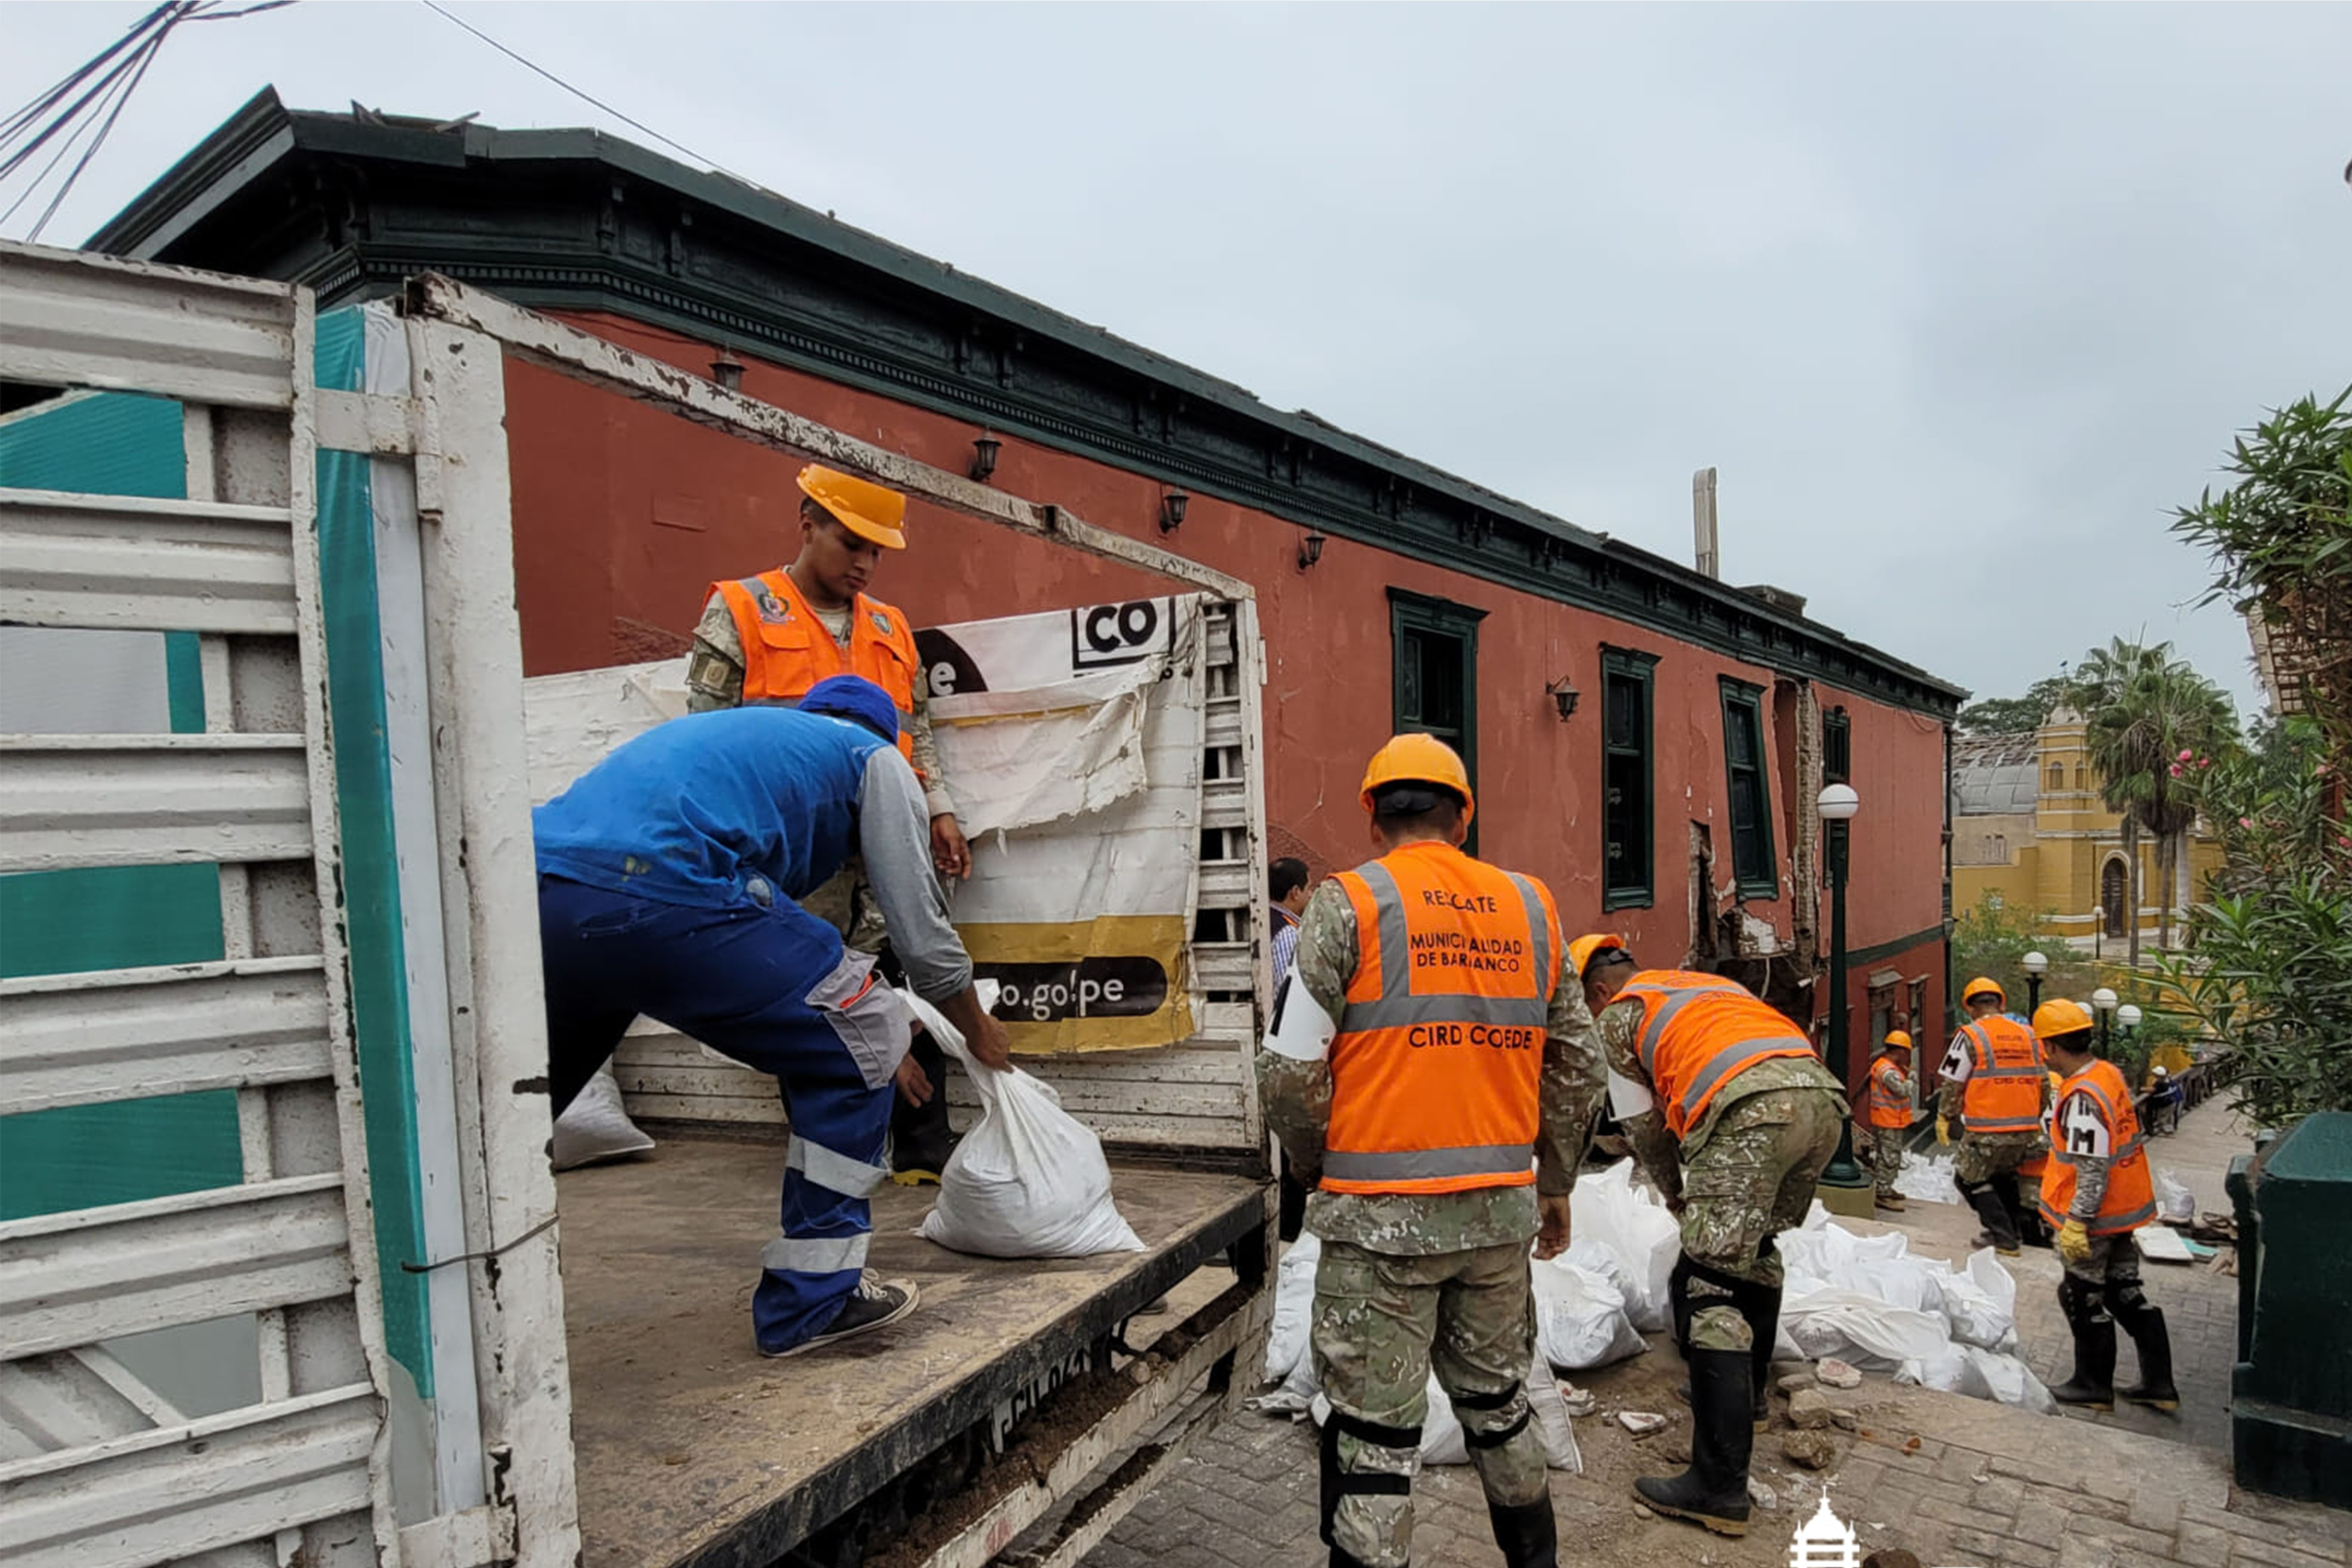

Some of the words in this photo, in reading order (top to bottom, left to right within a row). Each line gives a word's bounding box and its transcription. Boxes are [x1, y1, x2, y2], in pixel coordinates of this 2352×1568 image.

[1086, 600, 1157, 653] CO
[1411, 932, 1522, 955] MUNICIALIDAD
[1417, 952, 1436, 967] DE
[1409, 1025, 1461, 1047] CIRD
[1942, 1054, 1960, 1075] M
[2072, 1127, 2095, 1154] M
